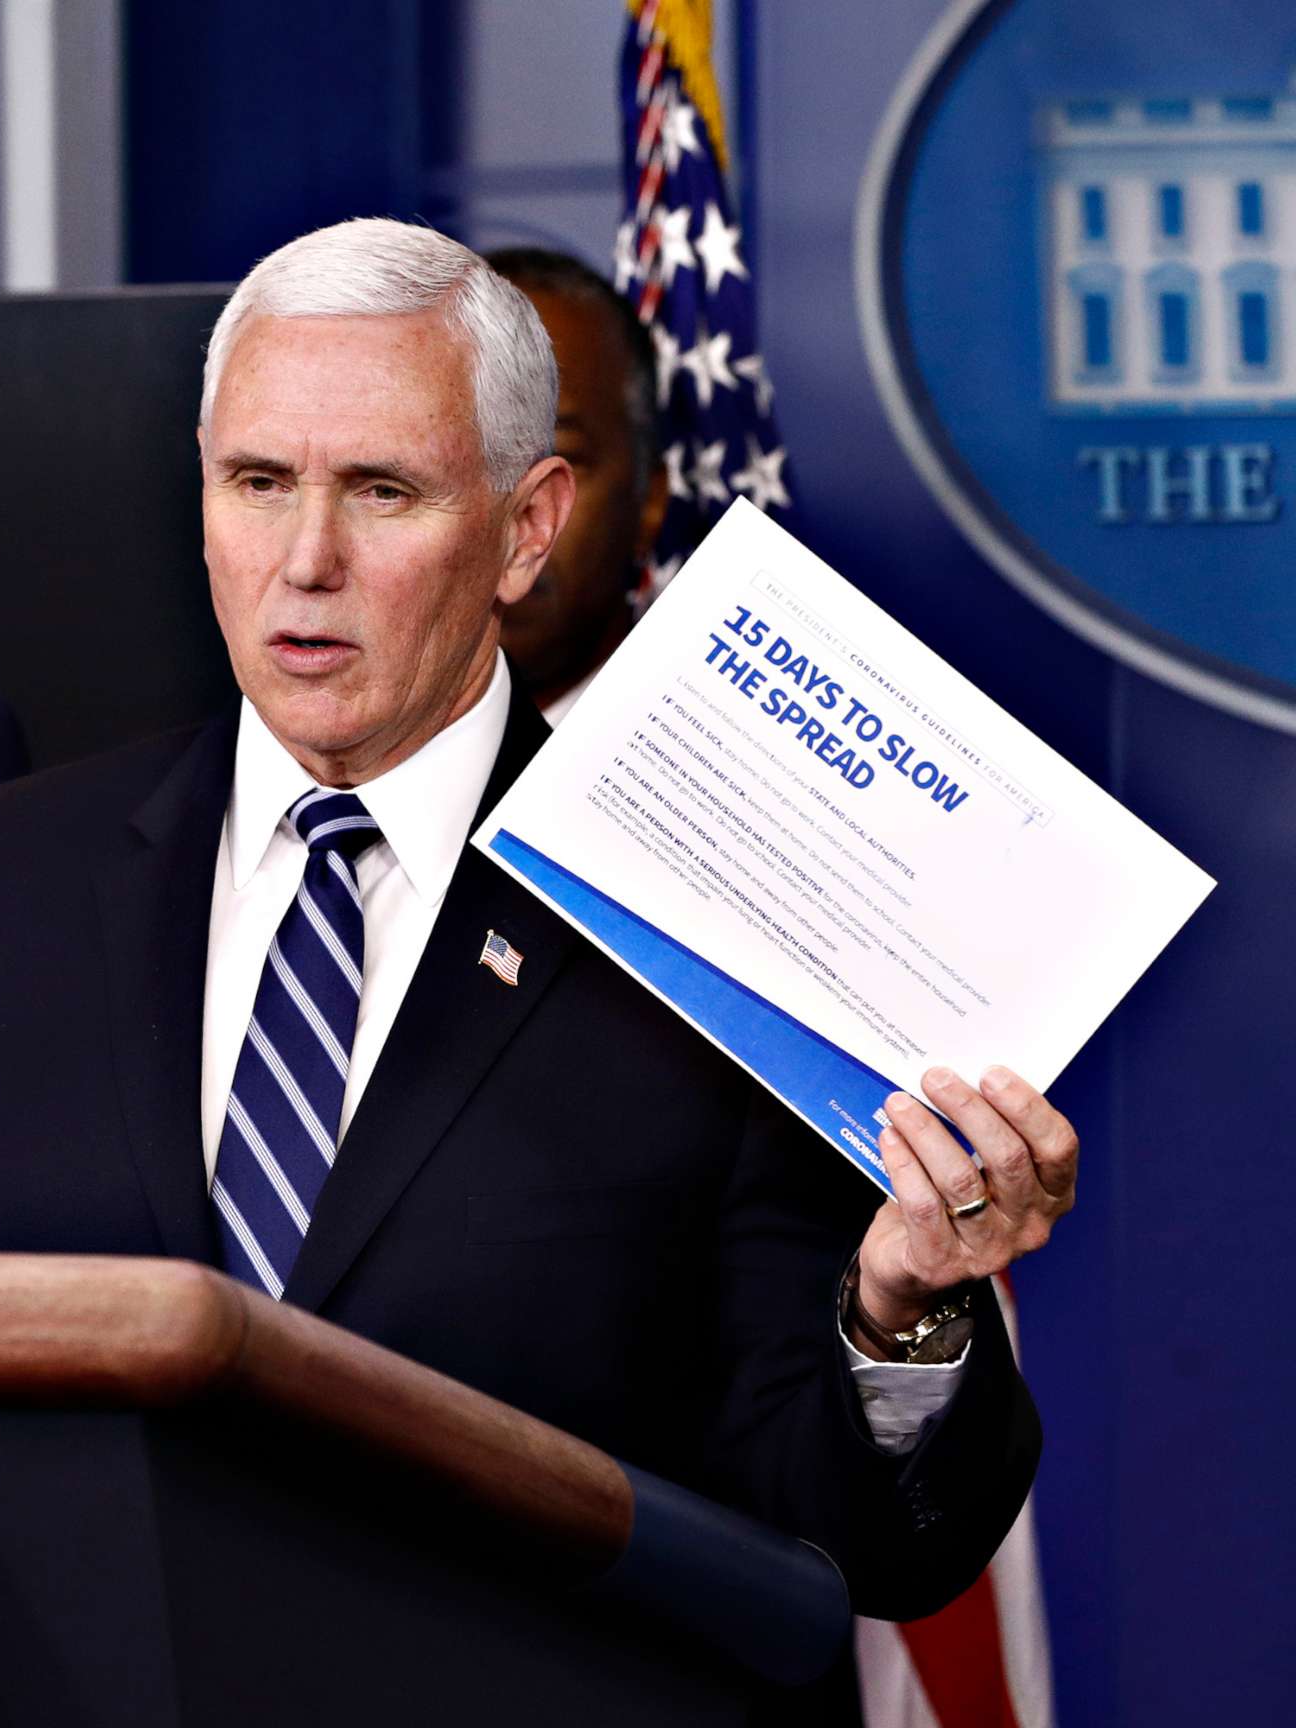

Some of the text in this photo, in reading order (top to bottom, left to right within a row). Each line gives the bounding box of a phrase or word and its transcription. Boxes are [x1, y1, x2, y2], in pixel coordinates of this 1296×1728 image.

[1078, 443, 1281, 525] THE
[707, 634, 874, 789] THE SPREAD
[725, 608, 968, 812] 15 DAYS TO SLOW
[764, 583, 783, 600] THE
[848, 653, 920, 714] CORONAVIRUS
[920, 712, 982, 766] GUIDELINES
[982, 764, 1003, 783] FOR
[599, 773, 612, 786] IF
[610, 783, 626, 798] YOU
[624, 795, 640, 810] ARE
[644, 812, 675, 841] PERSON
[672, 836, 694, 857] WITH
[697, 858, 731, 888] SERIOUS
[727, 883, 773, 924] UNDERLYING
[769, 920, 799, 947] HEALTH
[796, 943, 838, 981] CONDITION
[612, 756, 626, 769] IF
[623, 765, 640, 781] YOU
[637, 777, 654, 794] ARE
[651, 790, 665, 803] AN
[662, 799, 689, 823] OLDER
[685, 819, 720, 851] PERSON,
